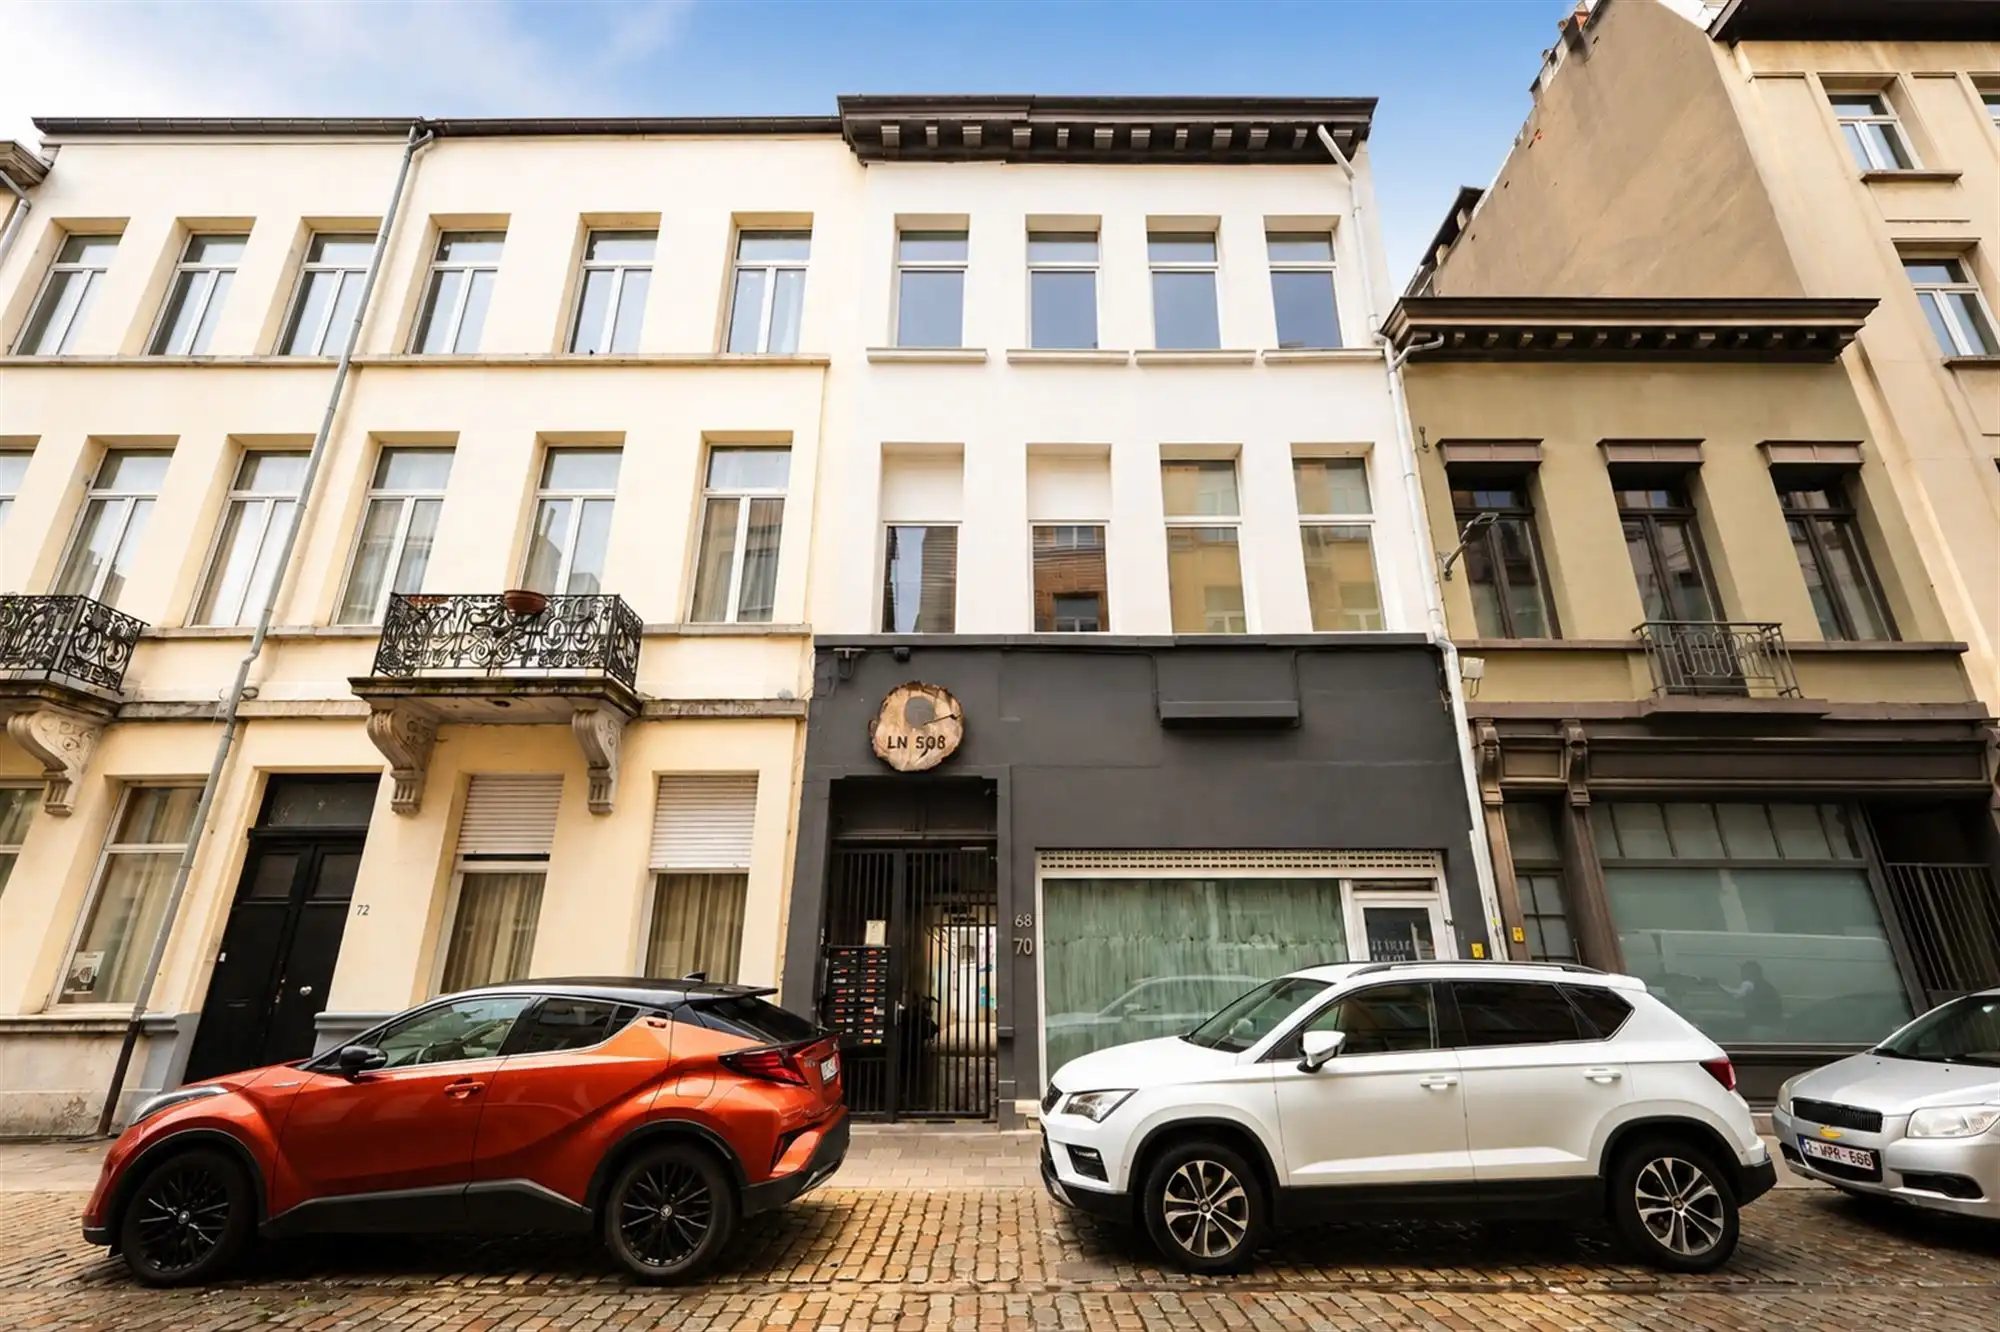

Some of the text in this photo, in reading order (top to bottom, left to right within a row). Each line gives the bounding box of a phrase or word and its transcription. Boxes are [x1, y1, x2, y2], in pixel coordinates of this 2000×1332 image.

[887, 735, 946, 750] LN 508
[357, 904, 370, 916] 72
[1015, 913, 1032, 928] 68
[1013, 937, 1032, 955] 70
